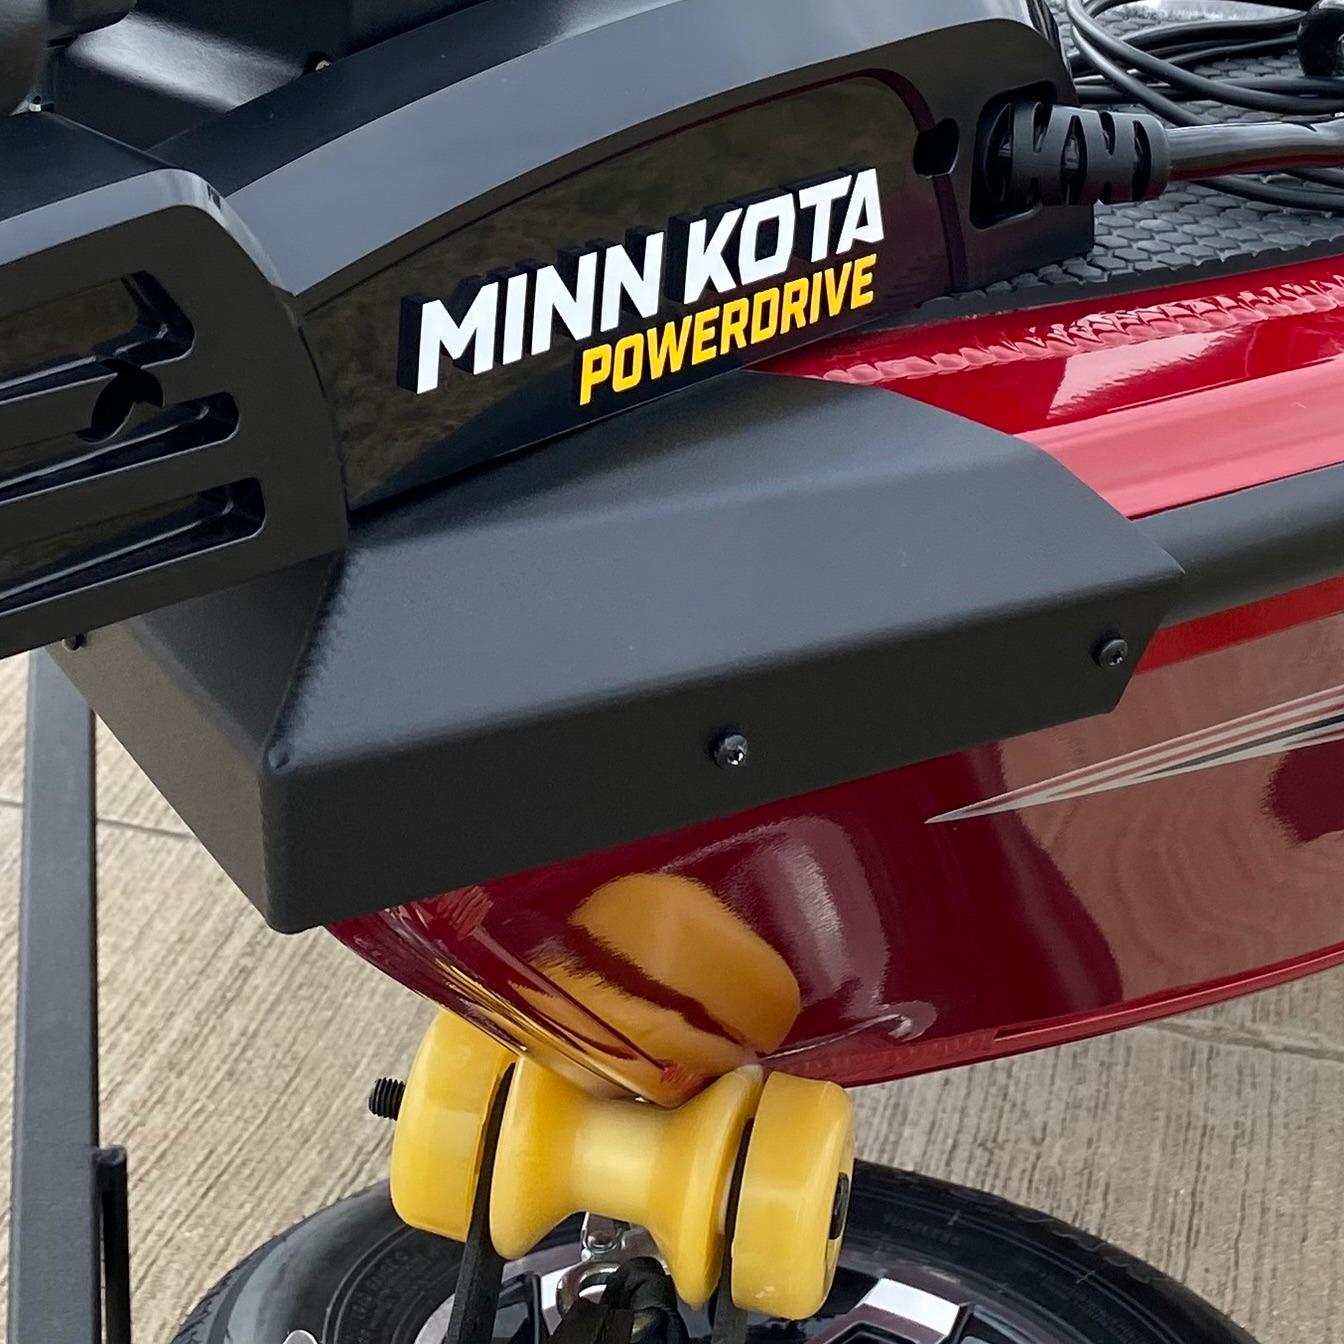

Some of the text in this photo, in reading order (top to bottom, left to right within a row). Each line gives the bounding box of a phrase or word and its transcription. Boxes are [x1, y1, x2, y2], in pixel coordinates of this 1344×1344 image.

[416, 166, 885, 395] MINN KOTA
[578, 252, 878, 406] POWERDRIVE
